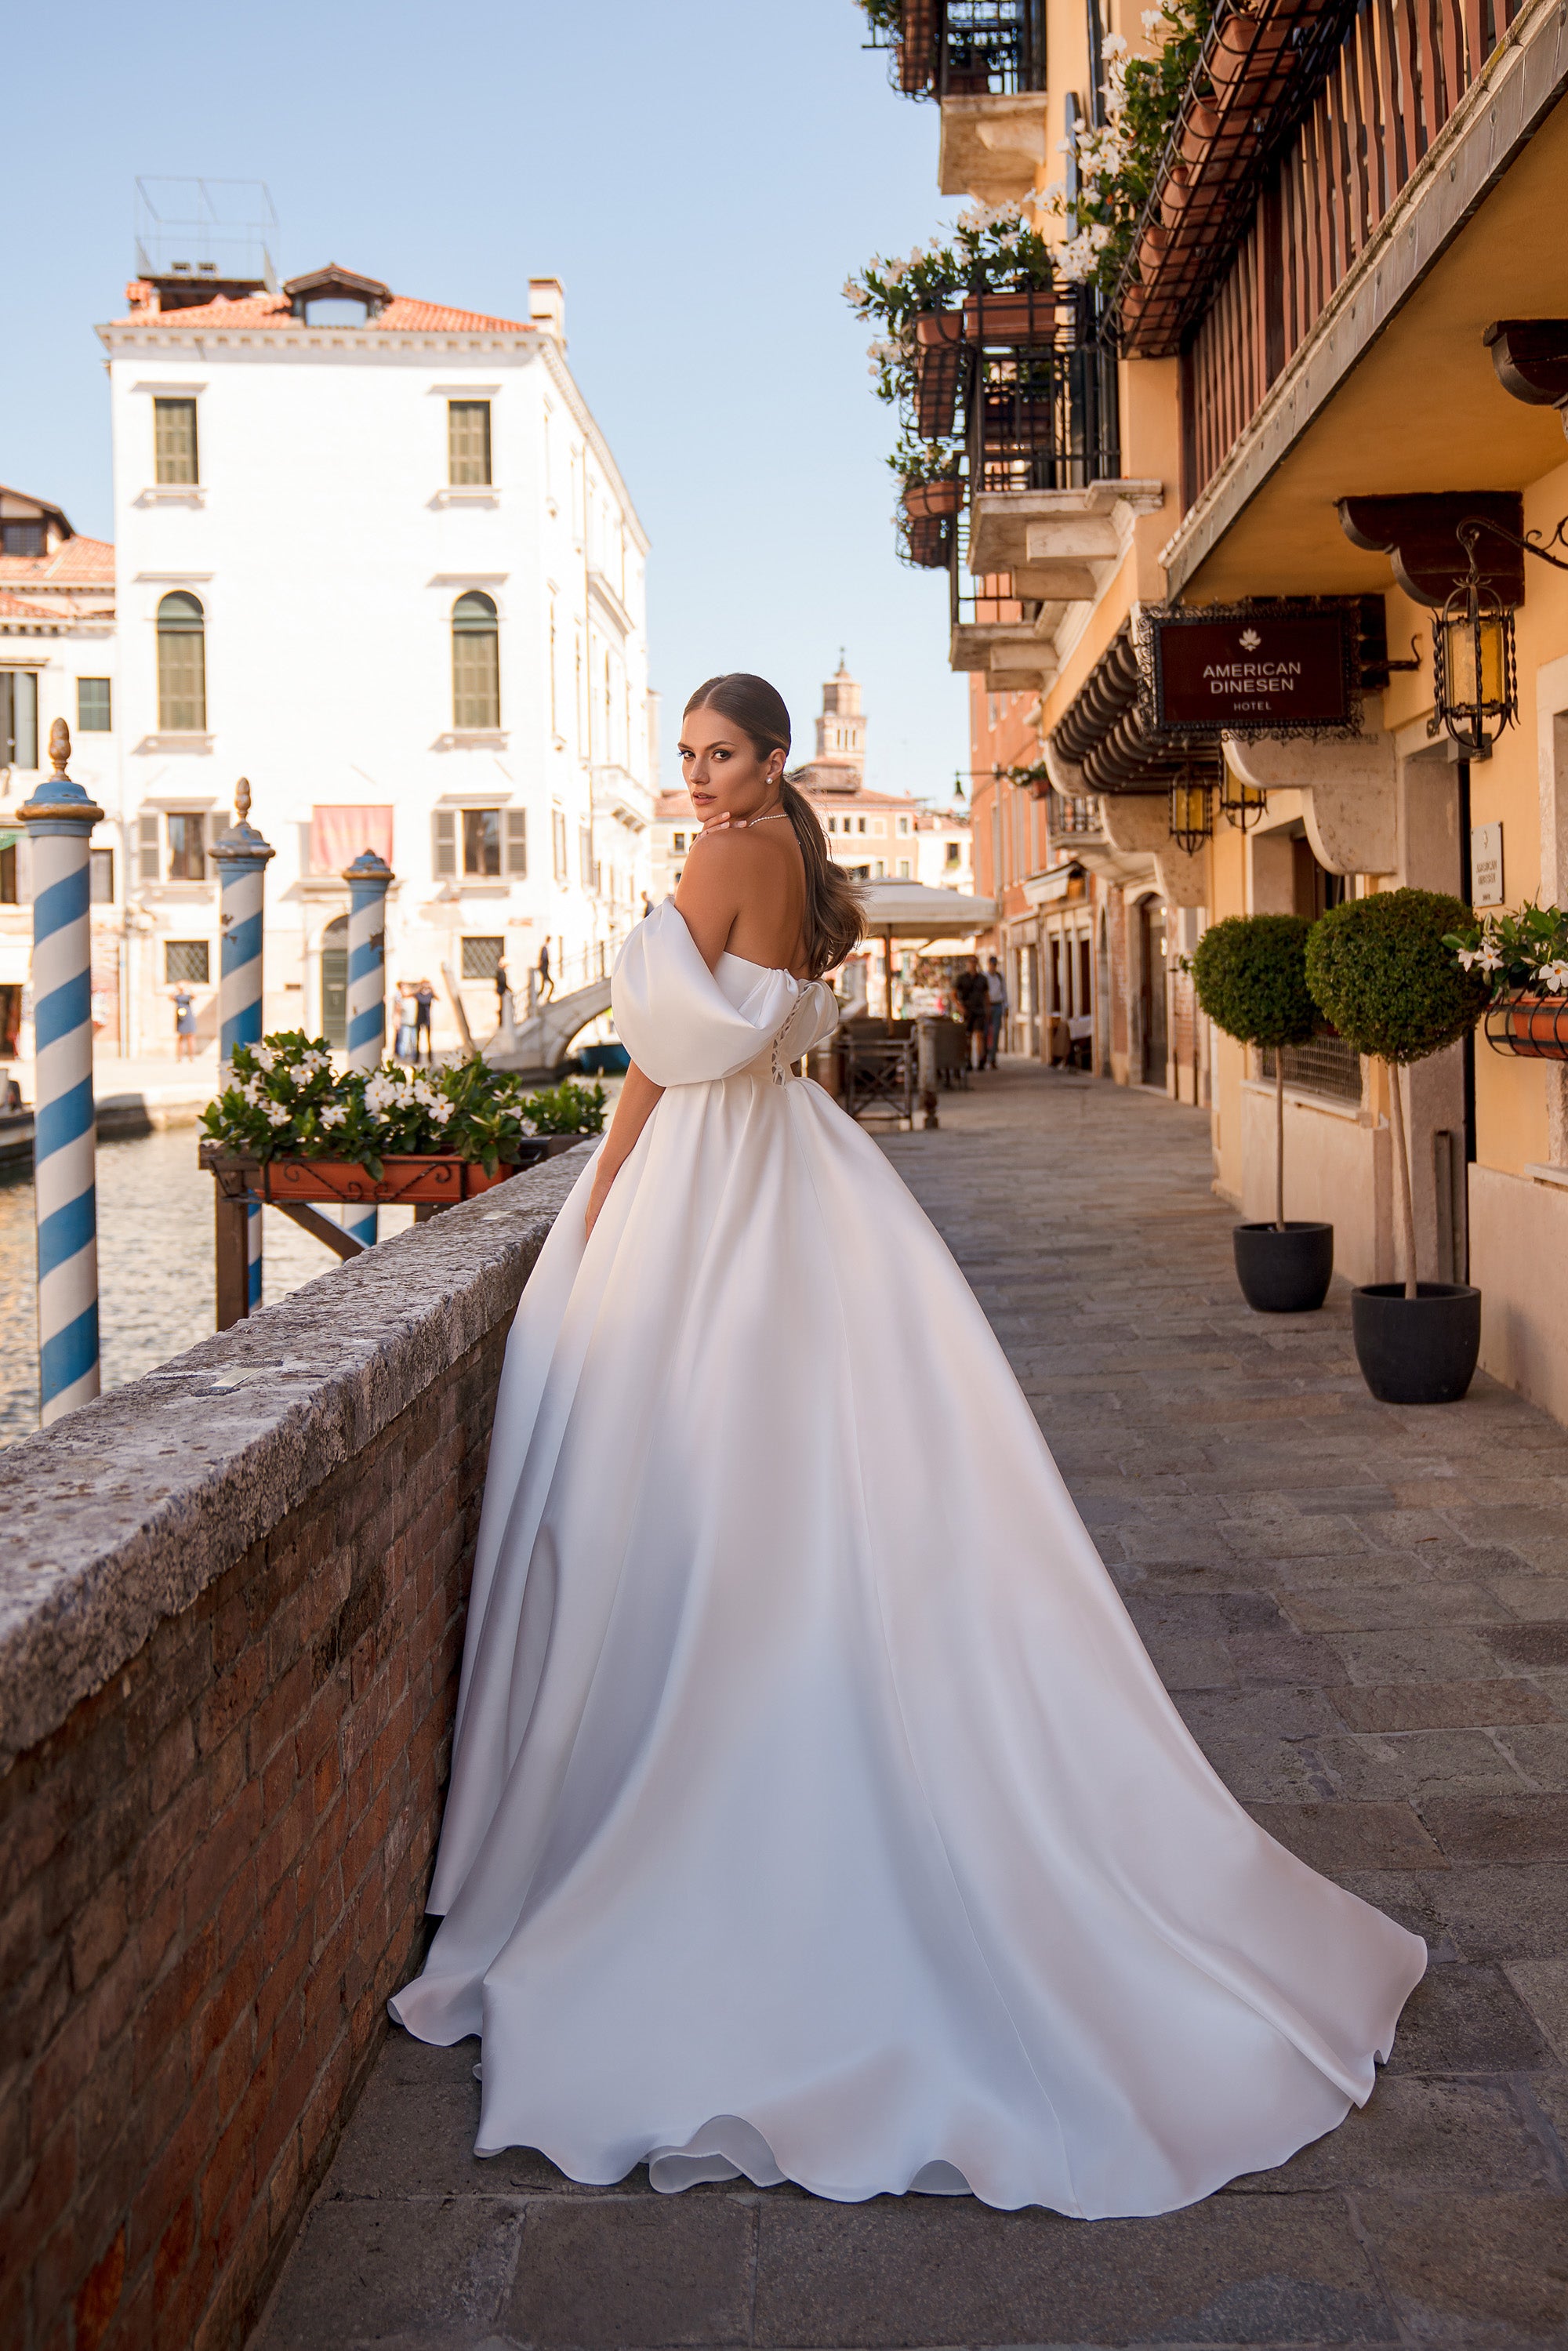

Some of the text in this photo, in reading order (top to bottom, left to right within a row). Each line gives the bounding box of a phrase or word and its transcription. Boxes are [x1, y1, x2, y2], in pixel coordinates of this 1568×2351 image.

[1203, 662, 1301, 679] AMERICAN
[1210, 678, 1294, 694] DINESEN
[1233, 701, 1272, 711] HOTEL
